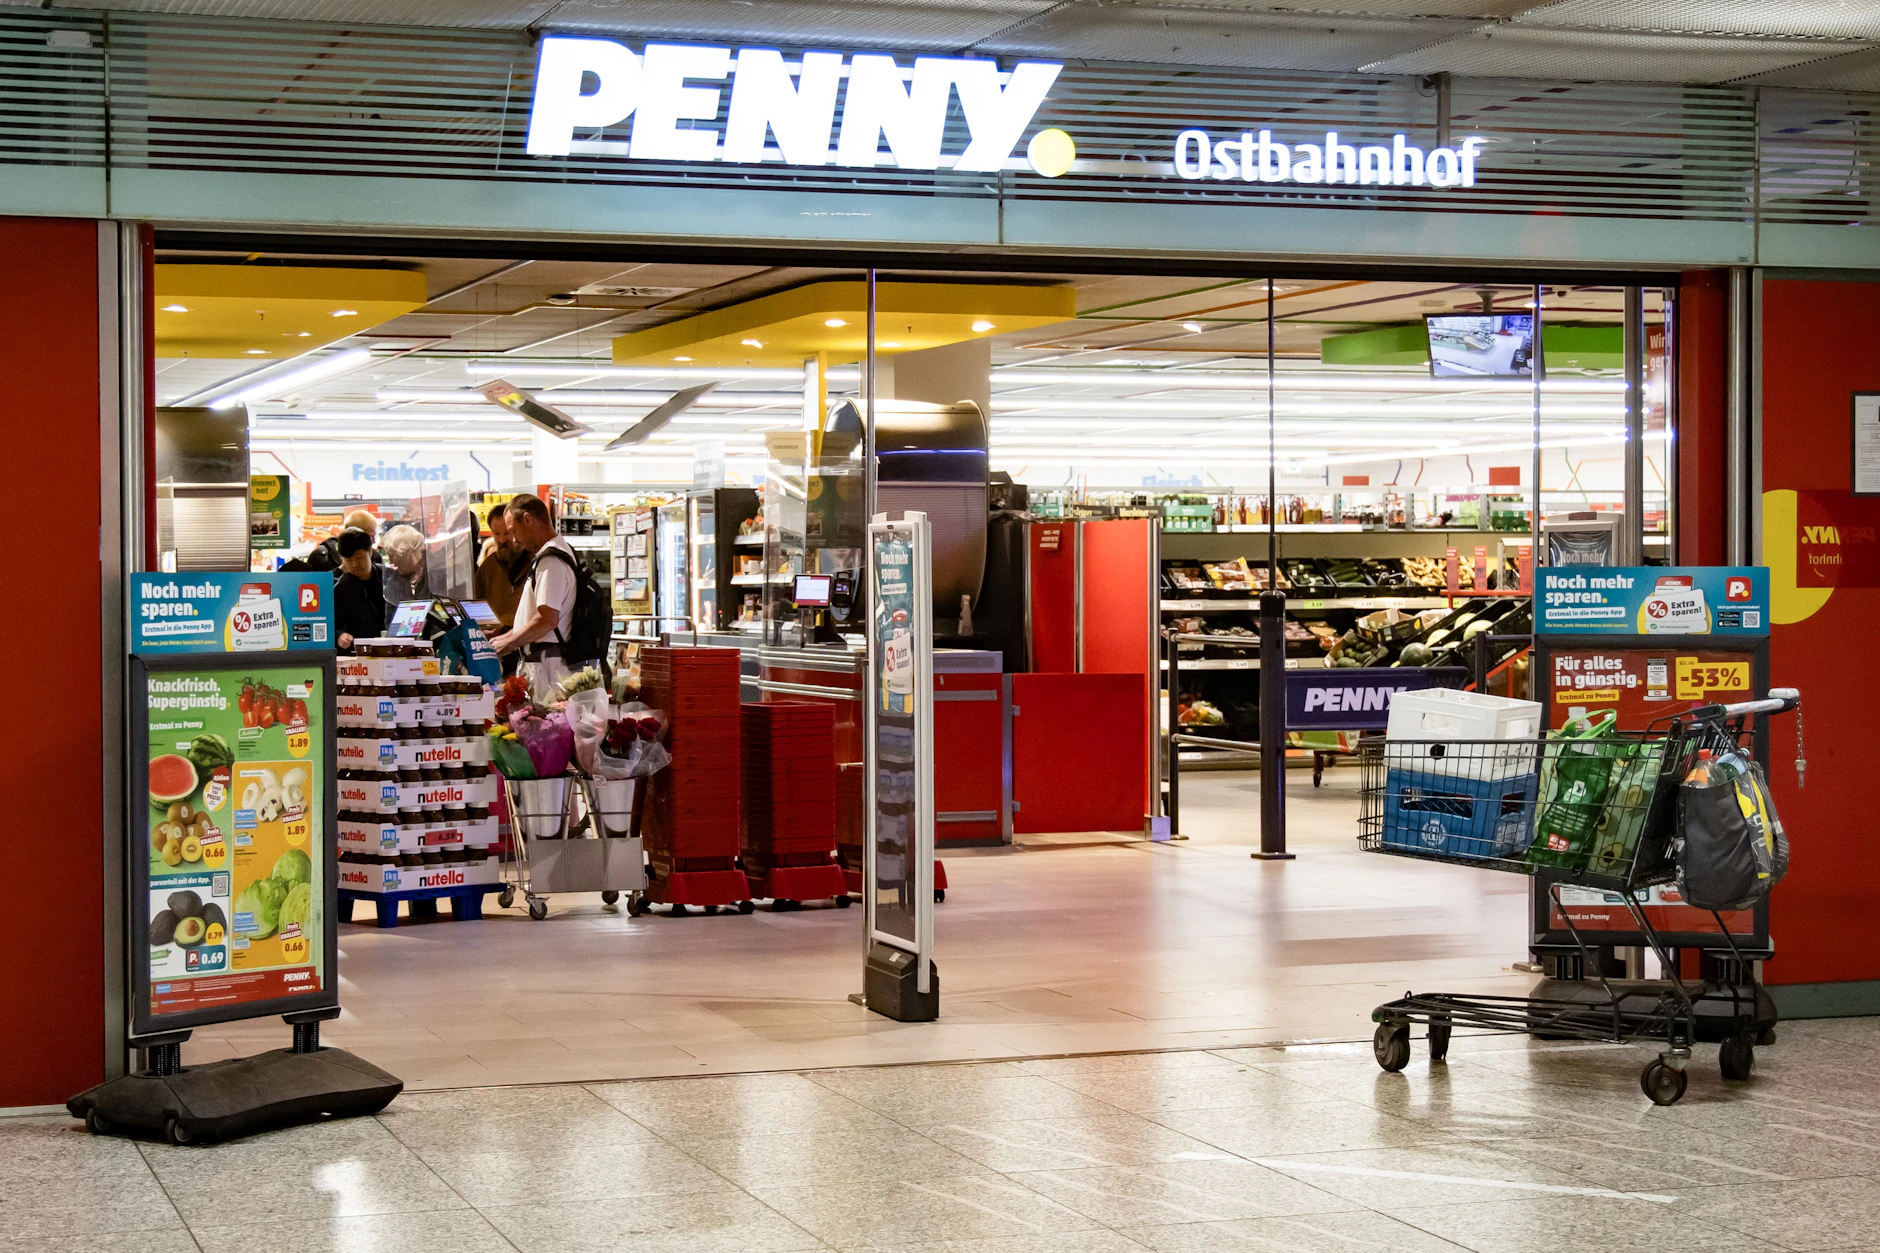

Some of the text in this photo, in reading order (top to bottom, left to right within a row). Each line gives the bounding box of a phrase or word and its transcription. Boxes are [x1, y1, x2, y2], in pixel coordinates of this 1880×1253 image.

[1174, 128, 1481, 189] Ostbahnhof
[352, 461, 449, 481] Feinkost
[880, 552, 895, 565] Noch
[1562, 549, 1602, 563] Noch mehr
[1545, 575, 1634, 590] Noch mehr
[141, 582, 221, 598] Noch mehr
[1671, 600, 1695, 609] Extra
[254, 612, 273, 622] Extra
[1590, 609, 1609, 618] Penny
[1610, 609, 1622, 617] App
[1671, 606, 1702, 617] sparen!
[183, 624, 199, 632] Penny
[201, 623, 211, 631] App
[254, 619, 280, 630] sparen!
[1555, 656, 1622, 670] Für alles
[341, 663, 368, 676] nutella
[1555, 671, 1571, 686] in
[1681, 667, 1741, 687] -53%
[148, 677, 221, 693] Knackfrisch.
[1595, 692, 1616, 701] Penny
[337, 704, 363, 716] nutella
[436, 708, 453, 716] 4.89
[150, 722, 174, 730] Erstmal
[183, 720, 203, 730] Penny
[290, 738, 308, 748] 1.89
[338, 745, 364, 758] nutella
[415, 746, 461, 762] nutella
[341, 789, 366, 800] nutella
[418, 787, 463, 803] nutella
[287, 825, 306, 836] 1.89
[341, 829, 366, 842] nutella
[205, 847, 225, 858] 0.66
[342, 871, 368, 884] nutella
[419, 870, 464, 886] nutella
[1590, 913, 1610, 921] Penny
[207, 931, 222, 940] 0.79
[284, 943, 303, 952] 0.66
[201, 952, 224, 964] 0.69
